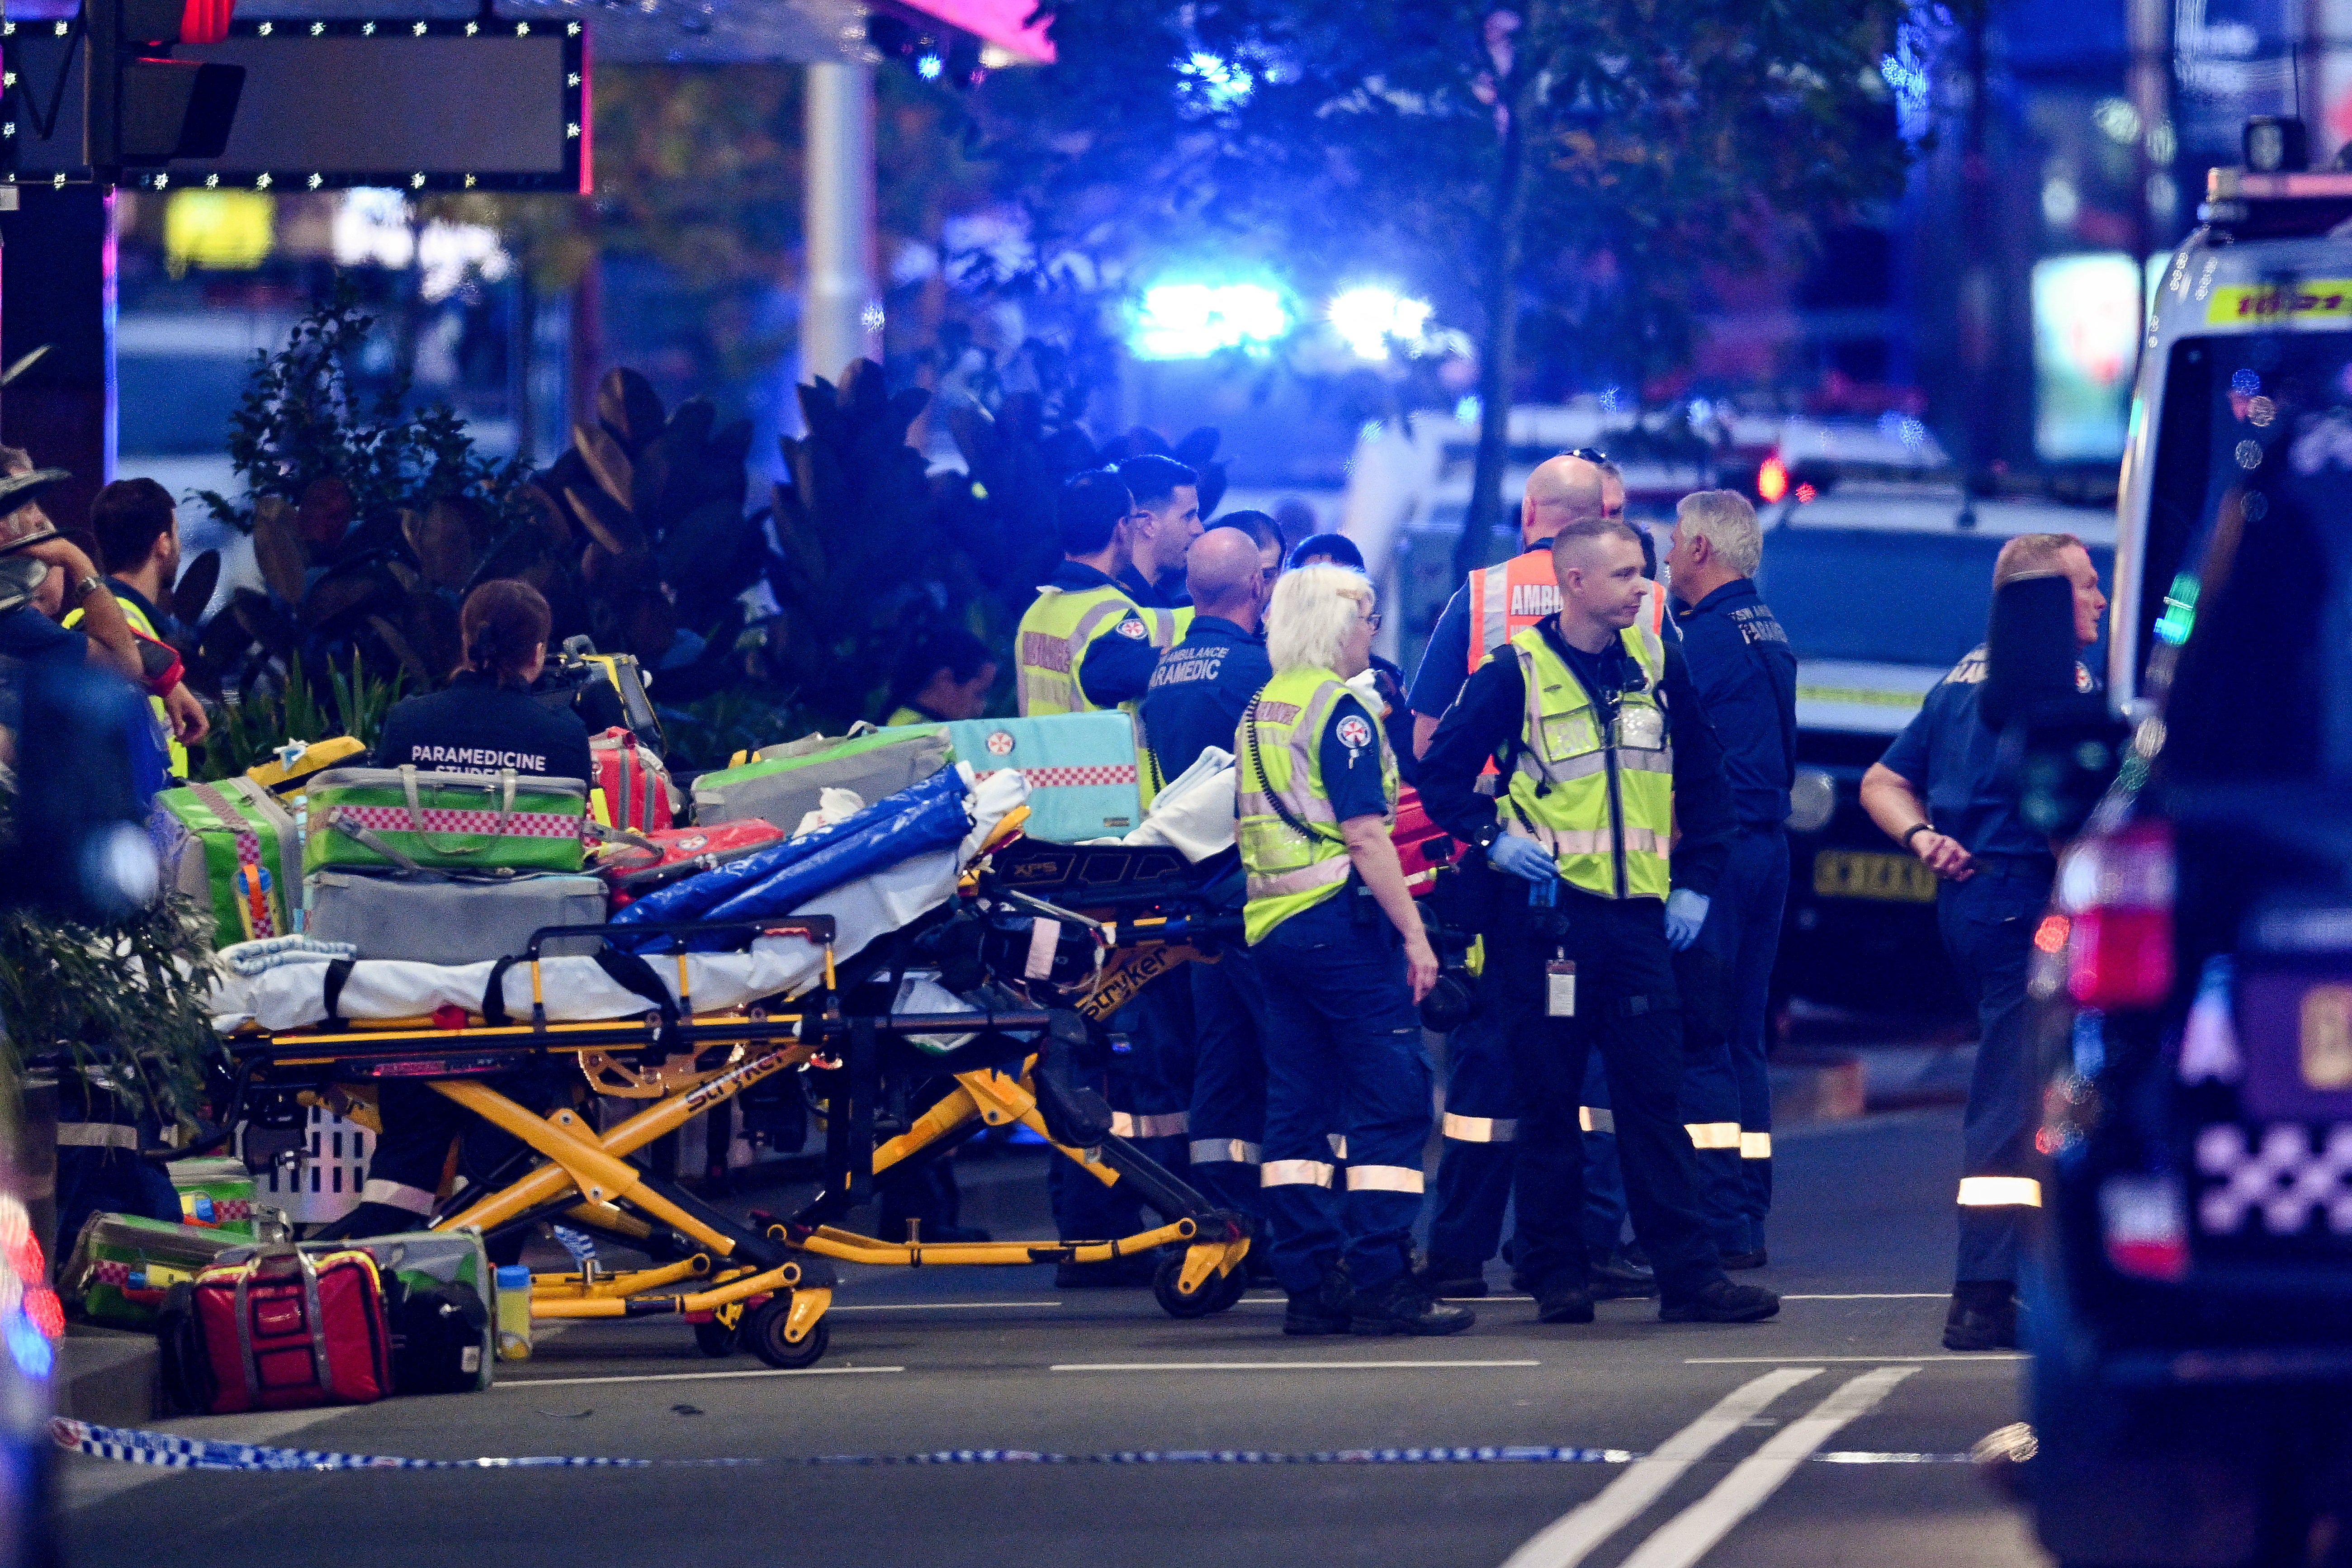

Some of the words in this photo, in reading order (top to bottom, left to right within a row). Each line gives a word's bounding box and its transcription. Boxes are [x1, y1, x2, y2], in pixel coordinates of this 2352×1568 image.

[1510, 584, 1564, 615] AMBU
[1148, 659, 1221, 690] ARAMEDIC
[412, 745, 546, 772] PARAMEDICINE
[1084, 947, 1167, 1018] stryker
